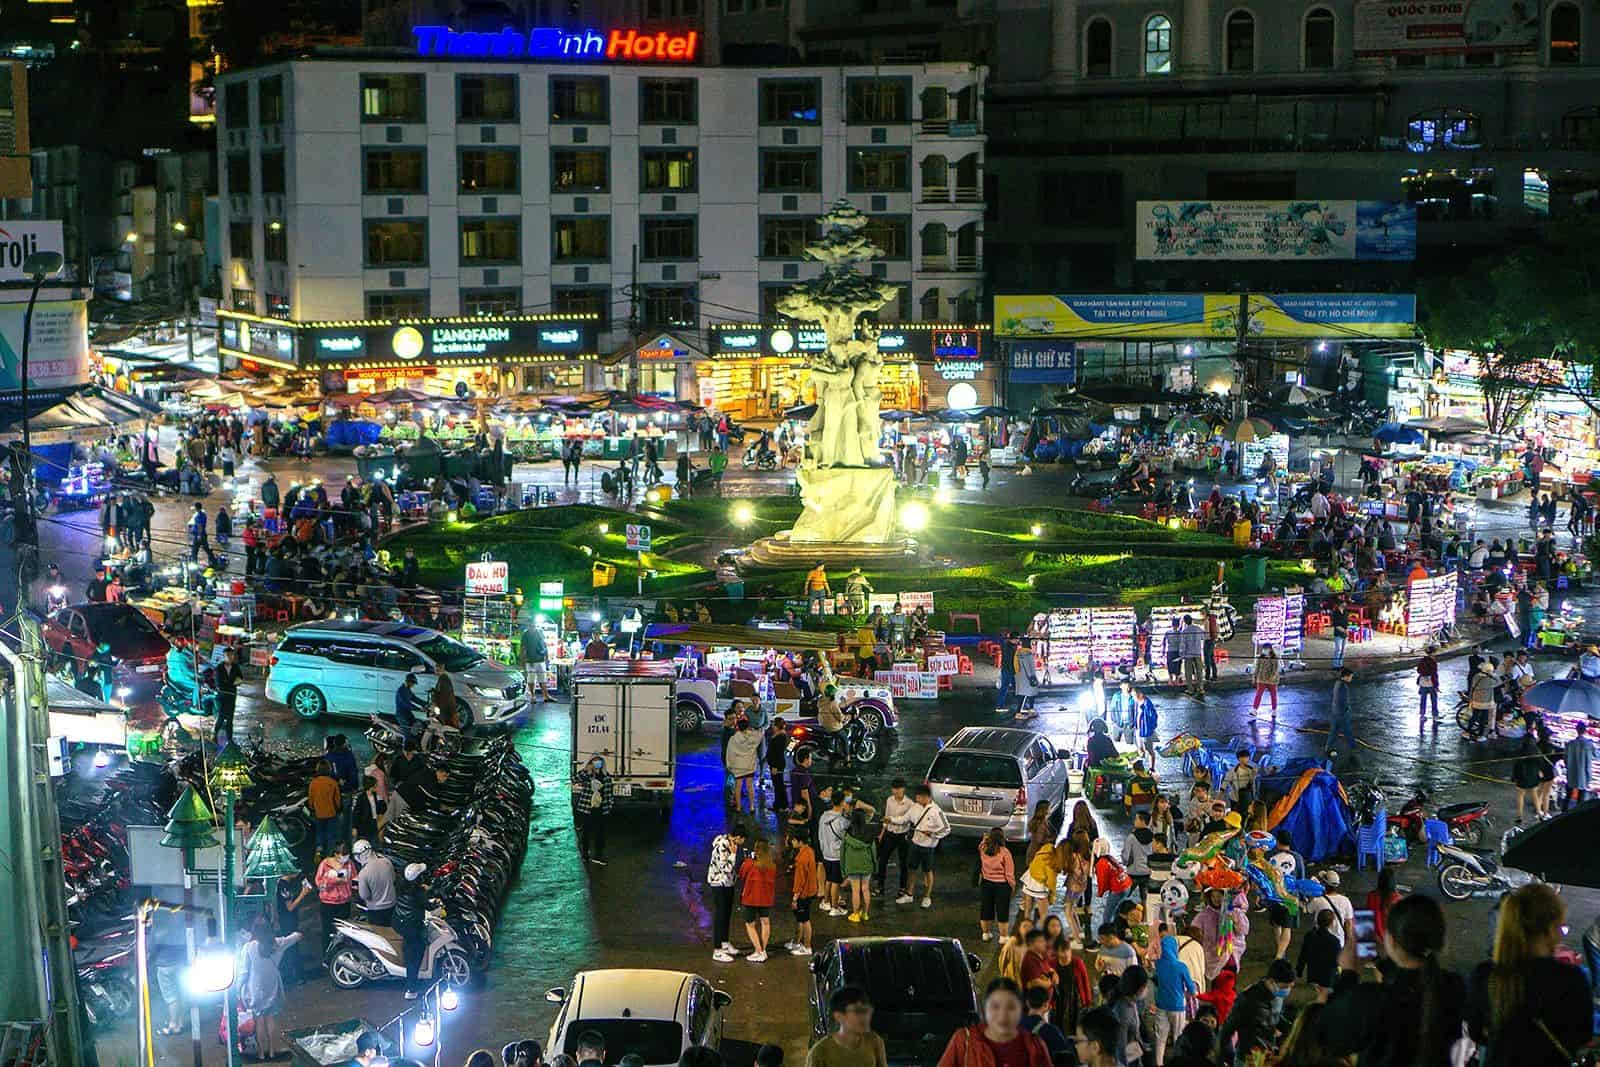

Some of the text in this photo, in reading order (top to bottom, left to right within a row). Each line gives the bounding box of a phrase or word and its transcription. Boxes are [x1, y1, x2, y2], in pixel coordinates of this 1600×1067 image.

[605, 29, 698, 58] Hotel
[433, 327, 509, 342] L'ANGFARM
[1057, 351, 1072, 369] XE
[942, 371, 976, 380] COFFEE
